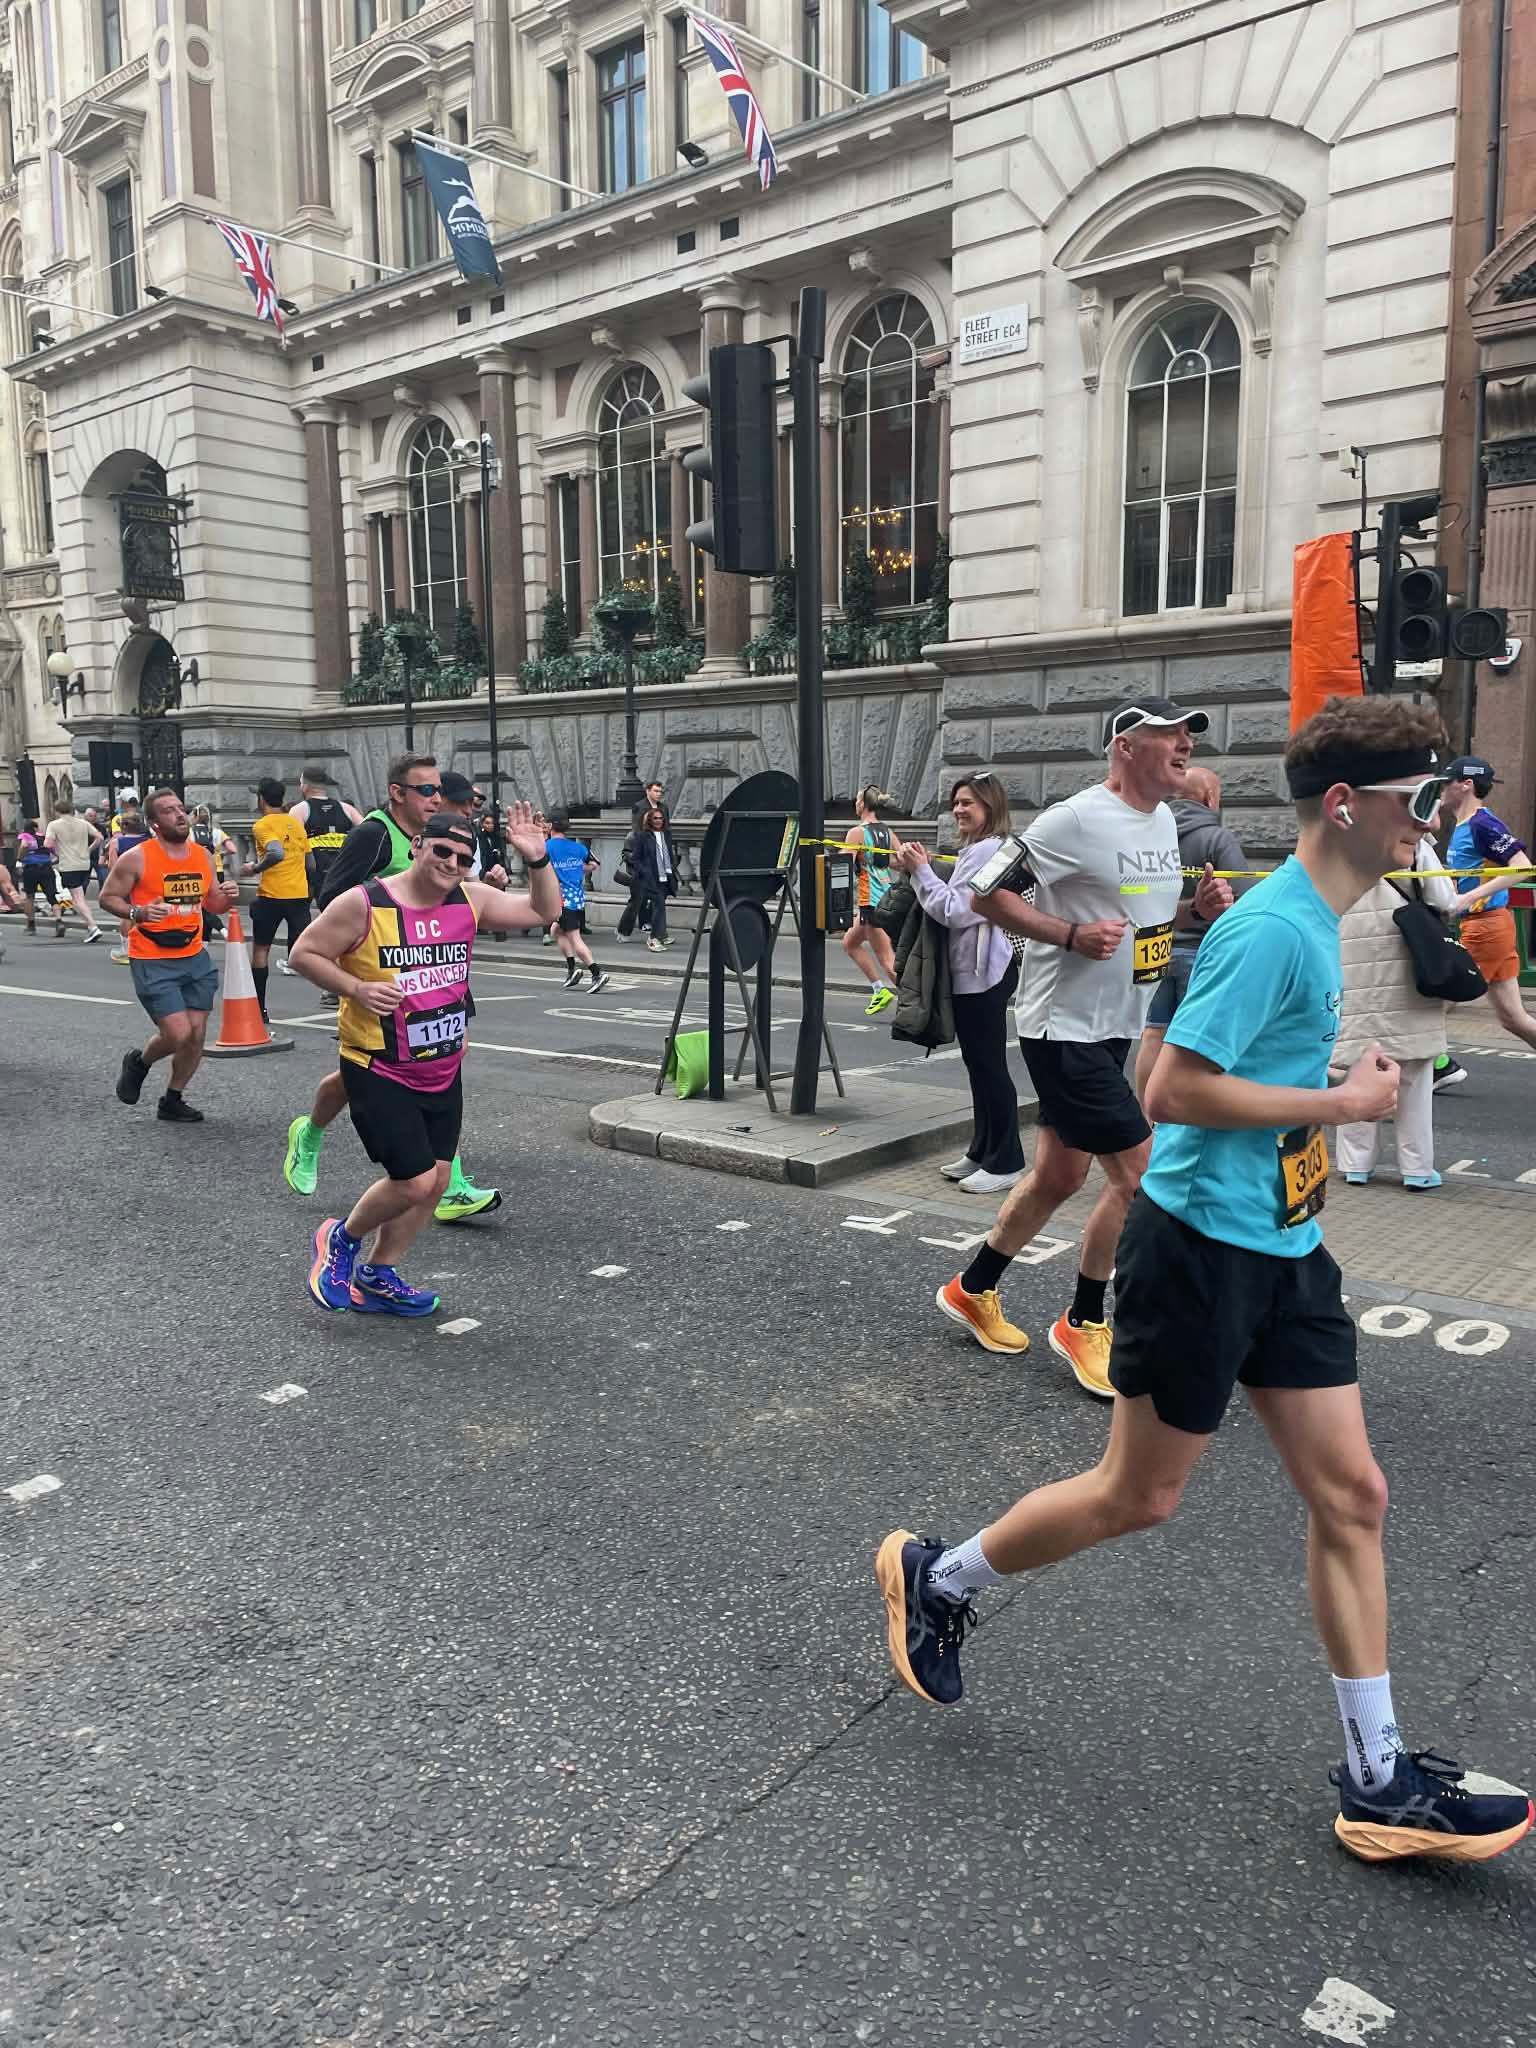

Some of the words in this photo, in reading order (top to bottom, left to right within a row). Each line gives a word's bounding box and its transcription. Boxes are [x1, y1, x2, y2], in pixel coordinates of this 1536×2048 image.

[965, 317, 991, 334] FLEET
[965, 329, 1000, 347] STREET
[1003, 323, 1021, 338] EC4
[171, 882, 199, 894] 4418
[383, 946, 432, 967] YOUNG
[435, 944, 467, 964] LIVES
[419, 964, 465, 989] CANCER
[421, 1016, 462, 1042] 1172
